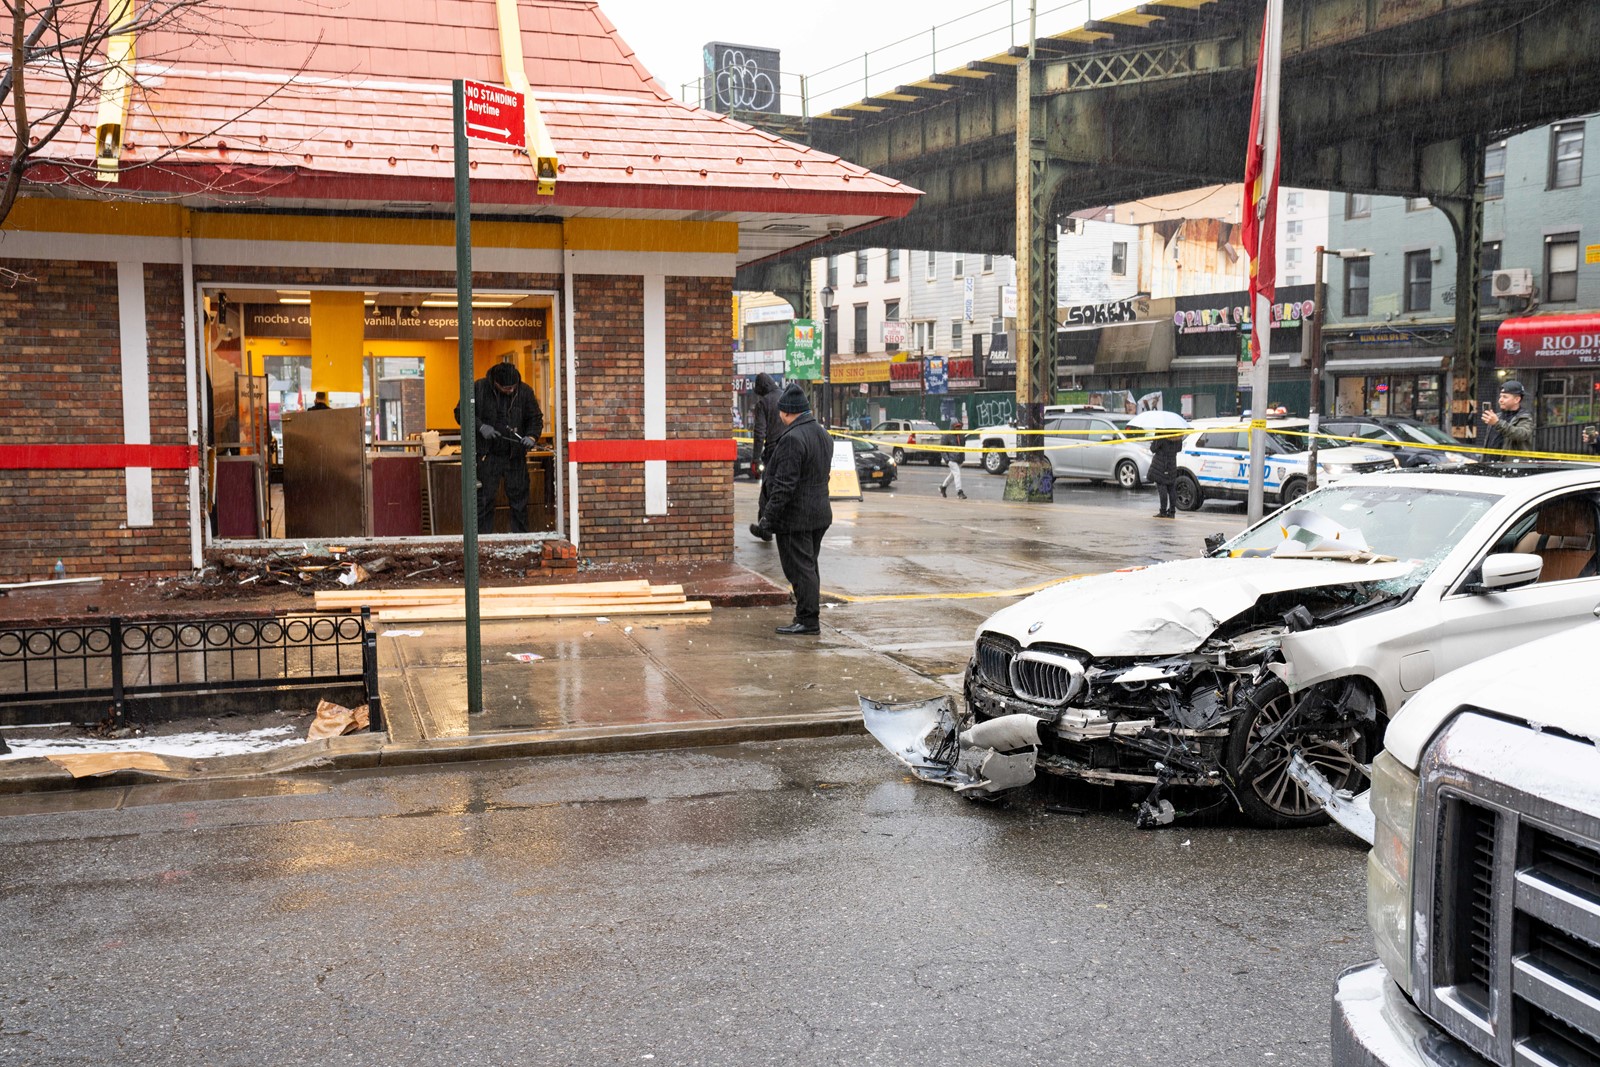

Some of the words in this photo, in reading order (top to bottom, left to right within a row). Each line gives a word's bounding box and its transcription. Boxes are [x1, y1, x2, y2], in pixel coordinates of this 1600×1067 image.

[467, 86, 479, 98] NO
[481, 89, 517, 107] STANDING
[468, 100, 500, 117] Anytime
[254, 313, 289, 324] mocha
[364, 316, 396, 326] vanilla
[399, 317, 421, 327] latte
[428, 318, 459, 329] espres
[478, 318, 494, 328] hot
[496, 317, 542, 328] chocolate
[1185, 308, 1229, 327] PARTY
[885, 335, 904, 343] SHOP
[1542, 335, 1575, 350] RIO
[1535, 348, 1591, 356] PRESCRIPTION
[846, 367, 865, 377] SING
[1238, 463, 1271, 479] ND
